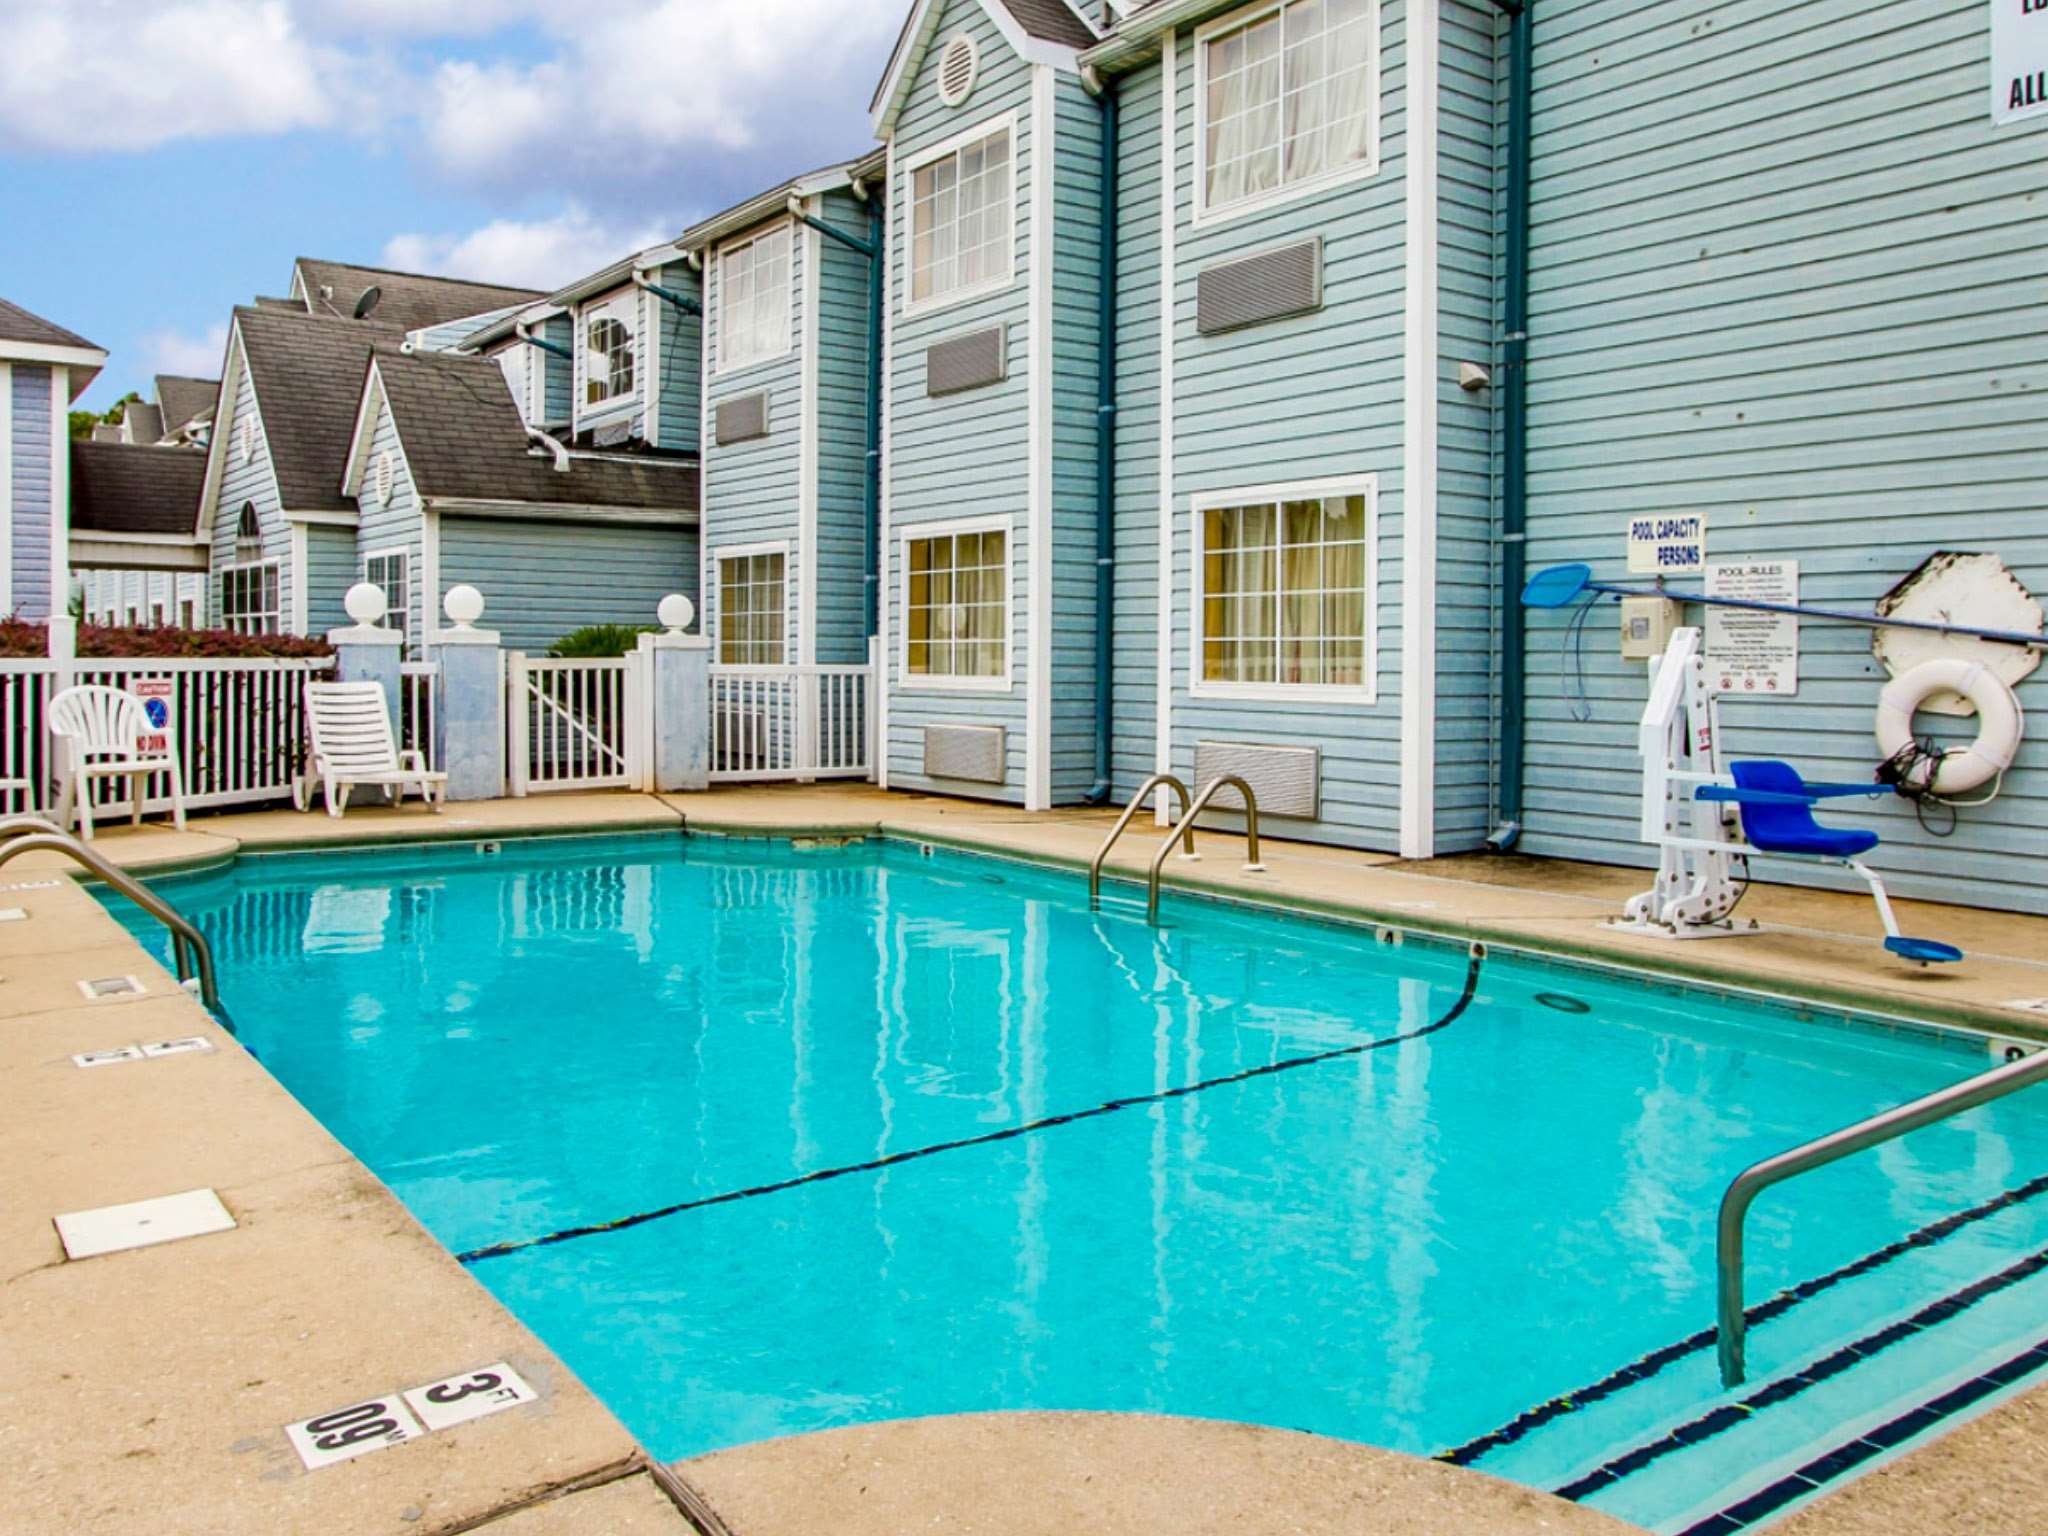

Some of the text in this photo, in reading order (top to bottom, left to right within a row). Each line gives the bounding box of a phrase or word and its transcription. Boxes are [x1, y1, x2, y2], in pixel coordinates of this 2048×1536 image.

[1632, 517, 1700, 541] POOL CAPACITY
[1658, 545, 1700, 567] PERSONS
[1718, 565, 1783, 577] POOL RULES
[425, 1373, 502, 1404] 3
